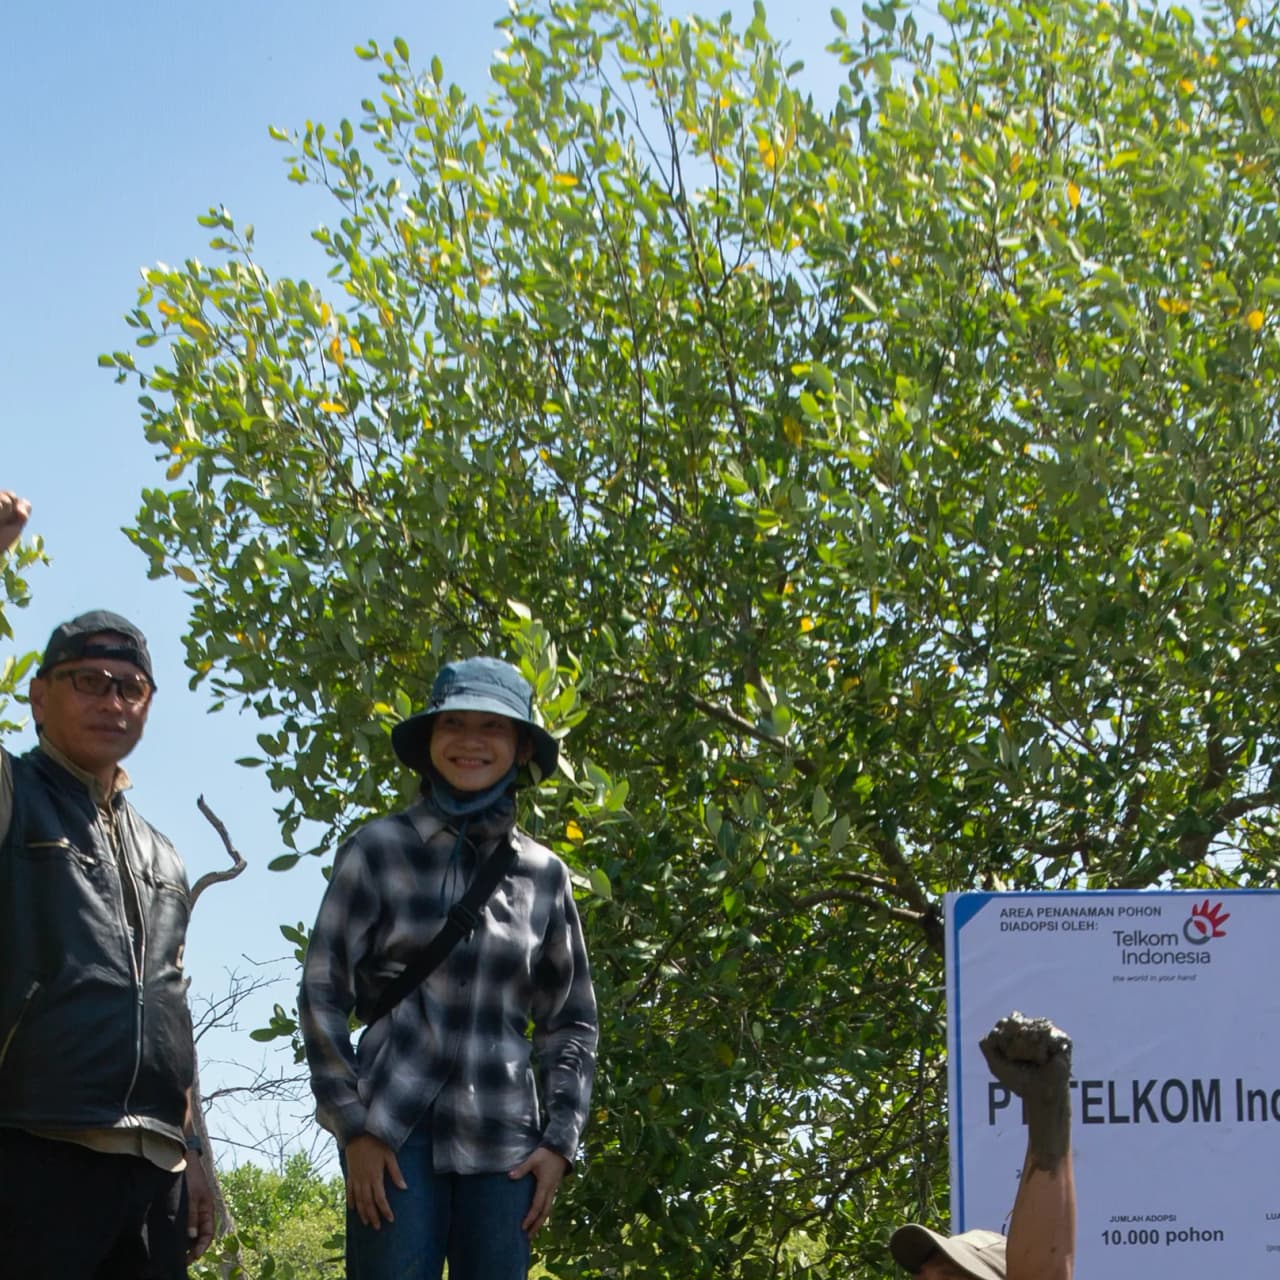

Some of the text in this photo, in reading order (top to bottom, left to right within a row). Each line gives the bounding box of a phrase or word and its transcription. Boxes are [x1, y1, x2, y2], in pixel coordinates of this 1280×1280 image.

[1000, 906, 1162, 918] AREA PENANAMAN POHON
[1000, 921, 1098, 932] DIADOPSI OLEH:
[1113, 930, 1178, 947] Telkom
[1122, 948, 1211, 965] Indonesia
[989, 1082, 1028, 1126] P
[1069, 1078, 1221, 1124] ELKOM
[1110, 1214, 1177, 1223] JUMLAH ADOPSI
[1101, 1227, 1224, 1246] 10.000 pohon
